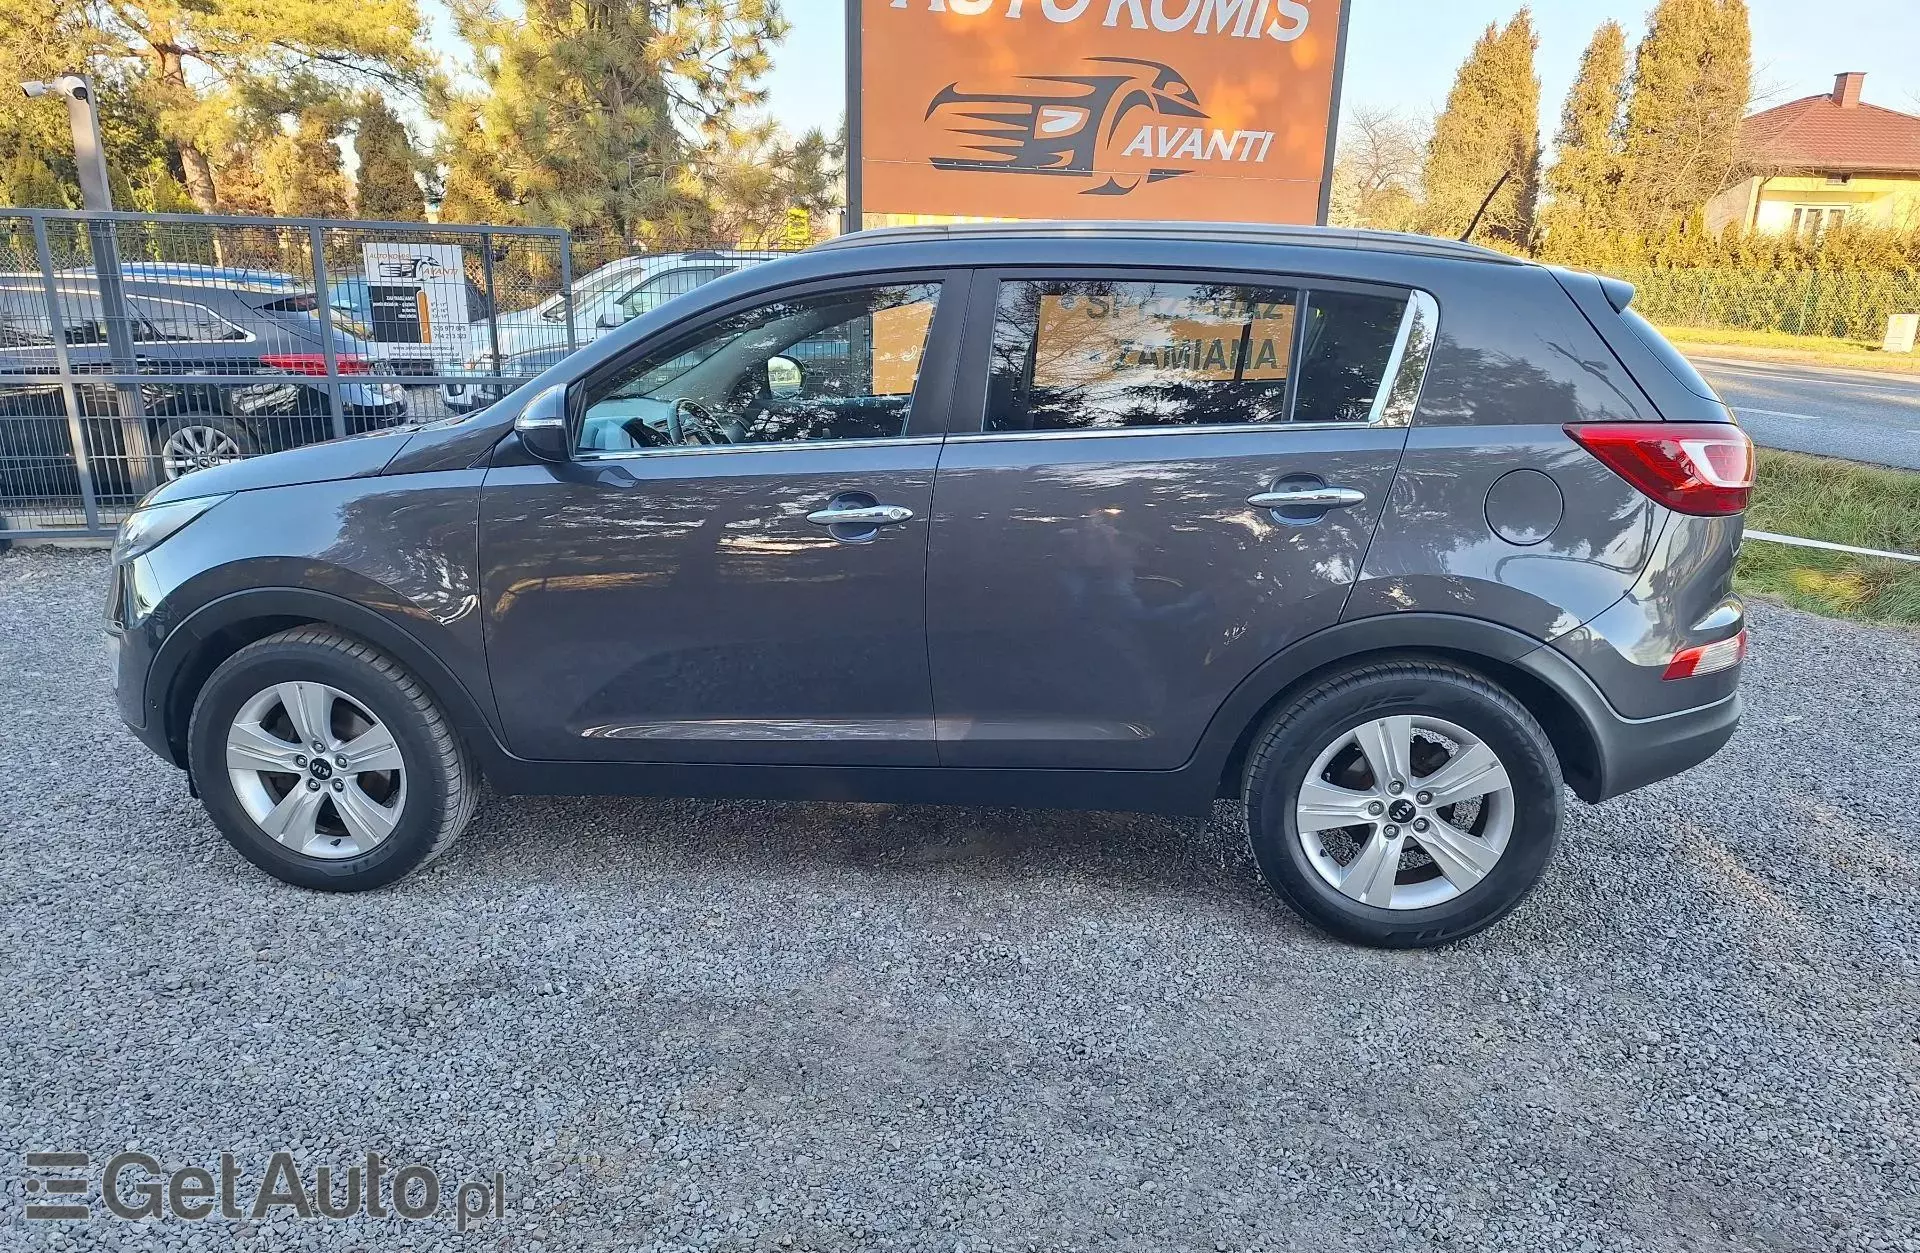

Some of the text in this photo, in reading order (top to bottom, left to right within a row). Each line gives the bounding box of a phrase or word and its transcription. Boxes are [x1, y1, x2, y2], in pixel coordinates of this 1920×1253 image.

[1121, 125, 1276, 163] AVANTI
[312, 762, 330, 777] KIA
[1392, 802, 1413, 820] KIA
